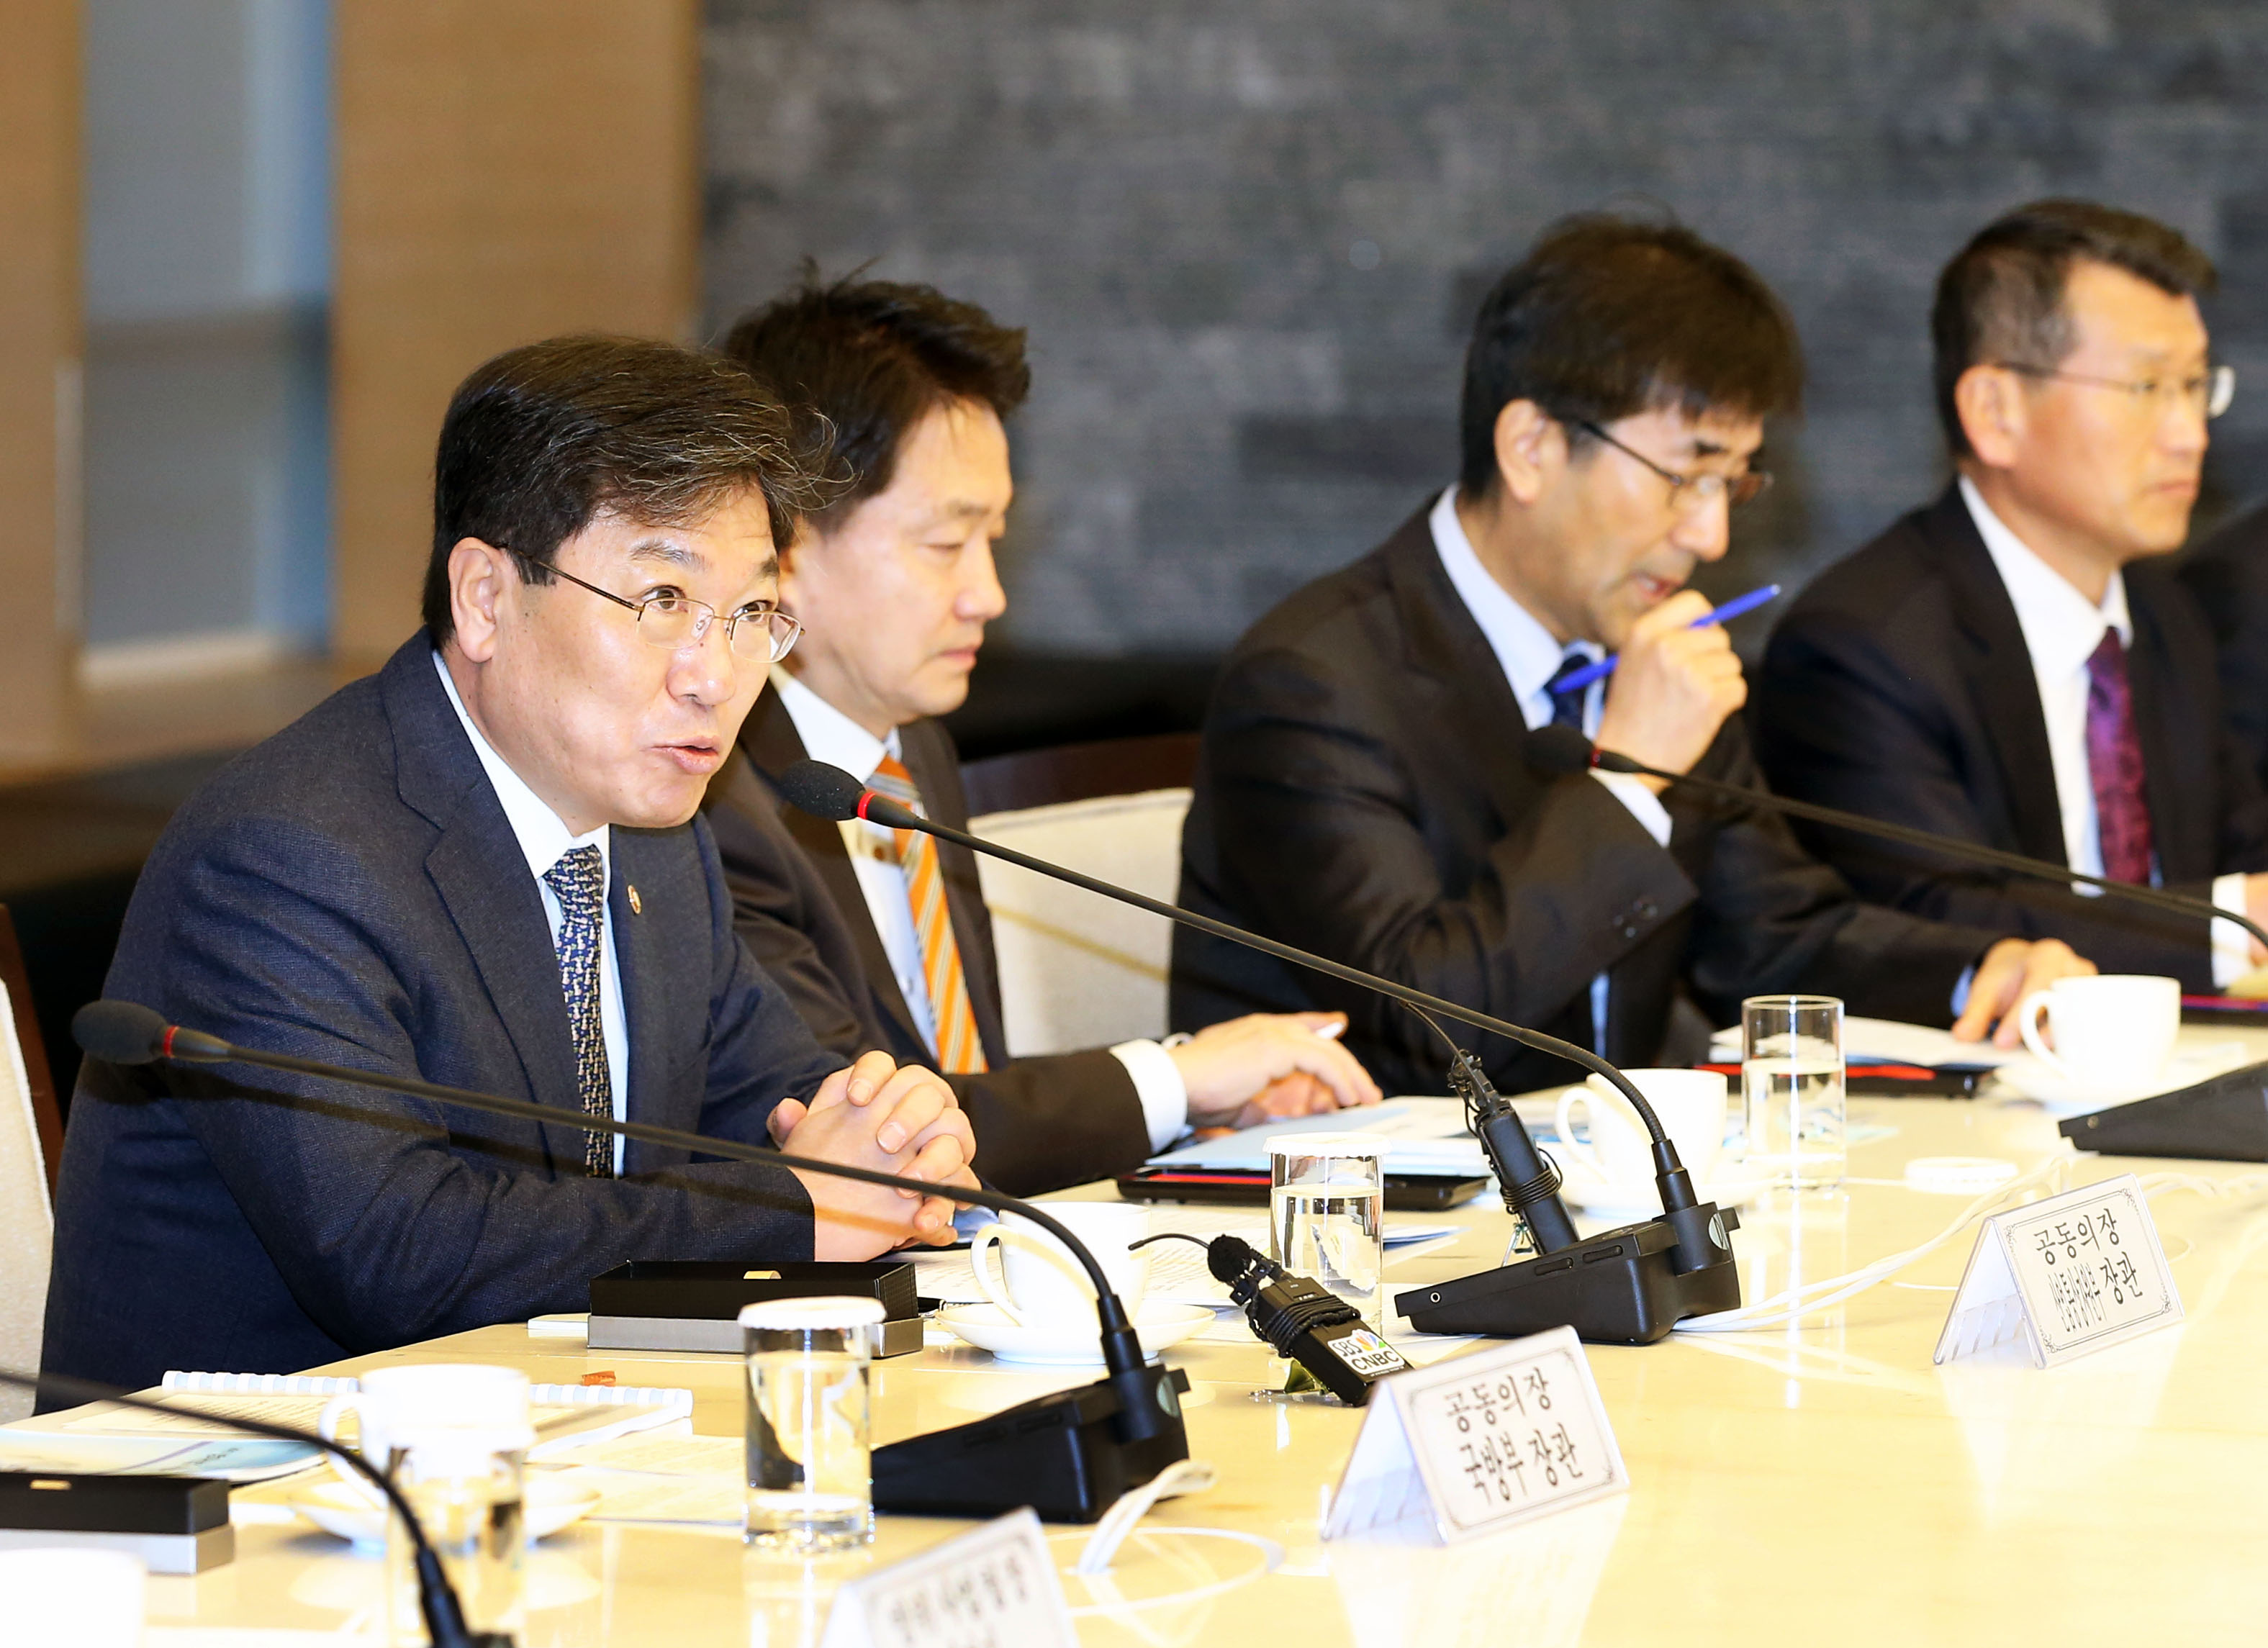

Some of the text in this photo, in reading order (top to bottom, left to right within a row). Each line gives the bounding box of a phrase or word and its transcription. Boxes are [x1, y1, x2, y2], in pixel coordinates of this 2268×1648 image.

[2033, 1208, 2120, 1265] 공동의장
[2099, 1251, 2143, 1305] 장관
[1332, 1339, 1363, 1357] SBS
[1350, 1350, 1400, 1370] CNBC
[1444, 1367, 1551, 1433] 공동의장
[1459, 1422, 1583, 1506] 국방부 장관
